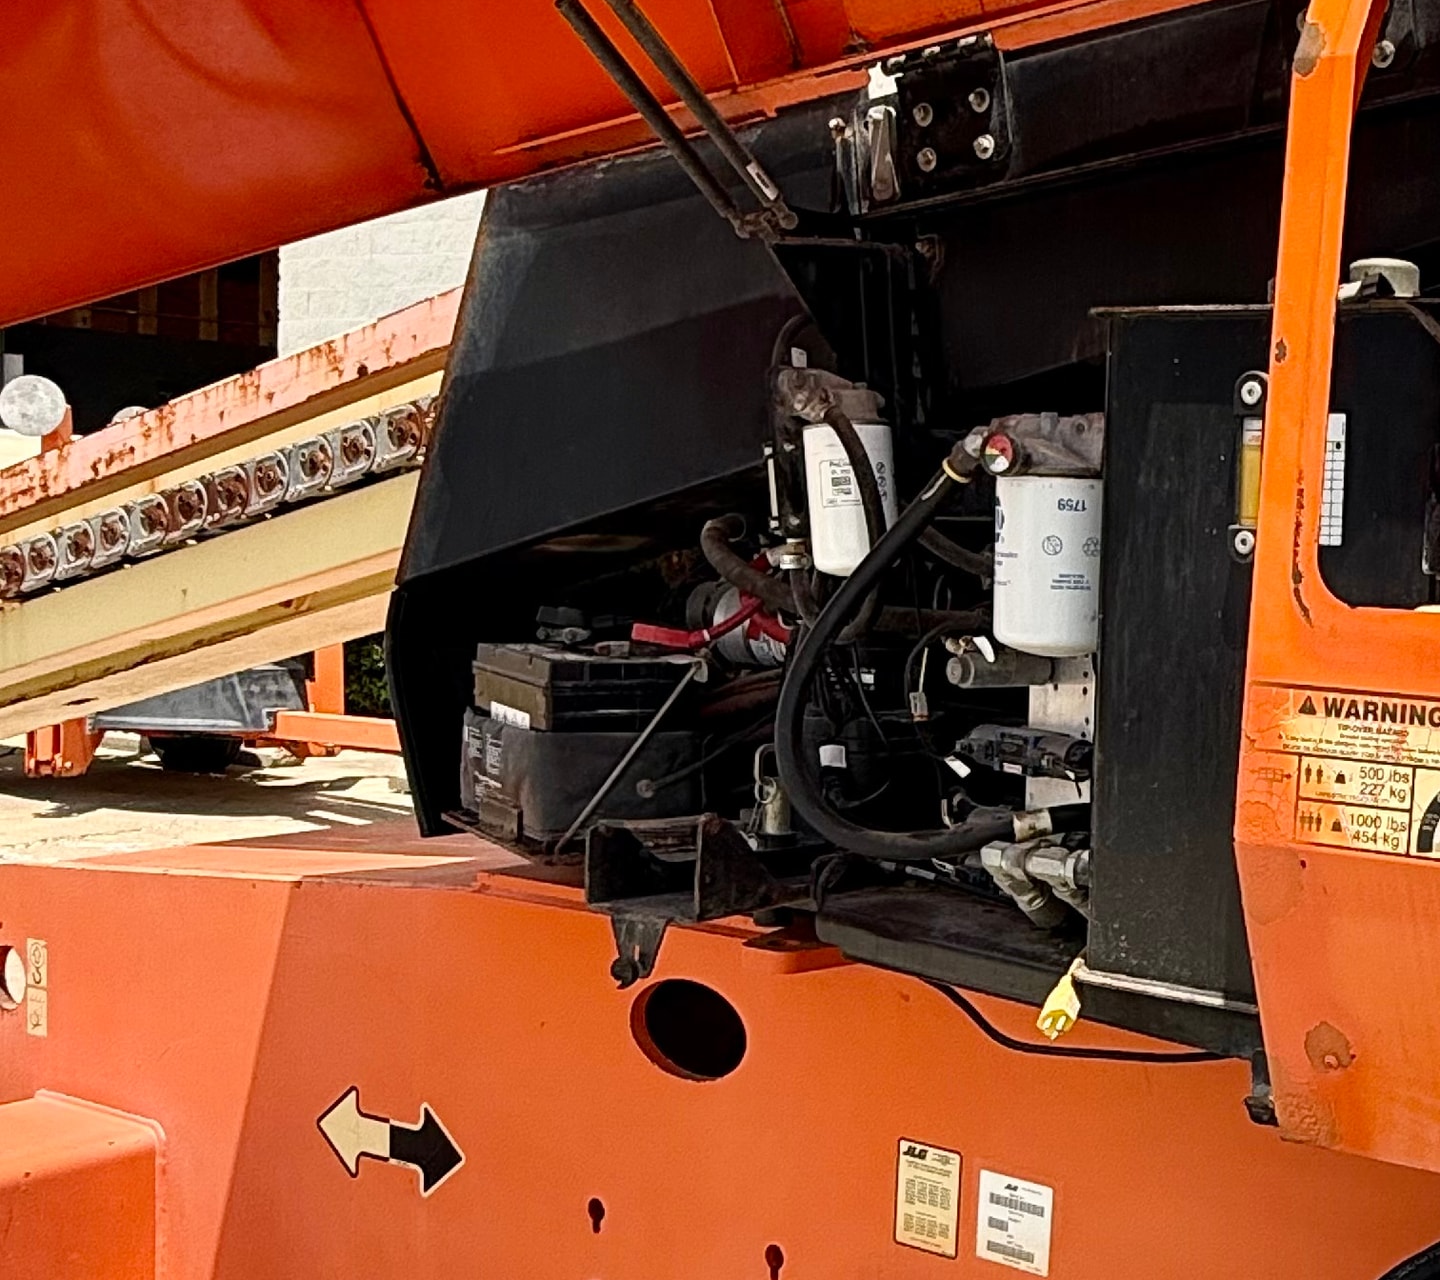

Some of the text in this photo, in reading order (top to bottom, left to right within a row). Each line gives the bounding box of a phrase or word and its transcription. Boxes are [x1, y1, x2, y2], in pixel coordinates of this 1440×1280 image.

[1057, 498, 1087, 512] 1759
[1359, 766, 1410, 783] 500 lbs
[1360, 782, 1384, 796] 227
[1389, 785, 1407, 803] kg
[1349, 813, 1408, 832] 1000 lbs
[1352, 830, 1399, 850] 454 kg
[902, 1145, 929, 1160] JLG
